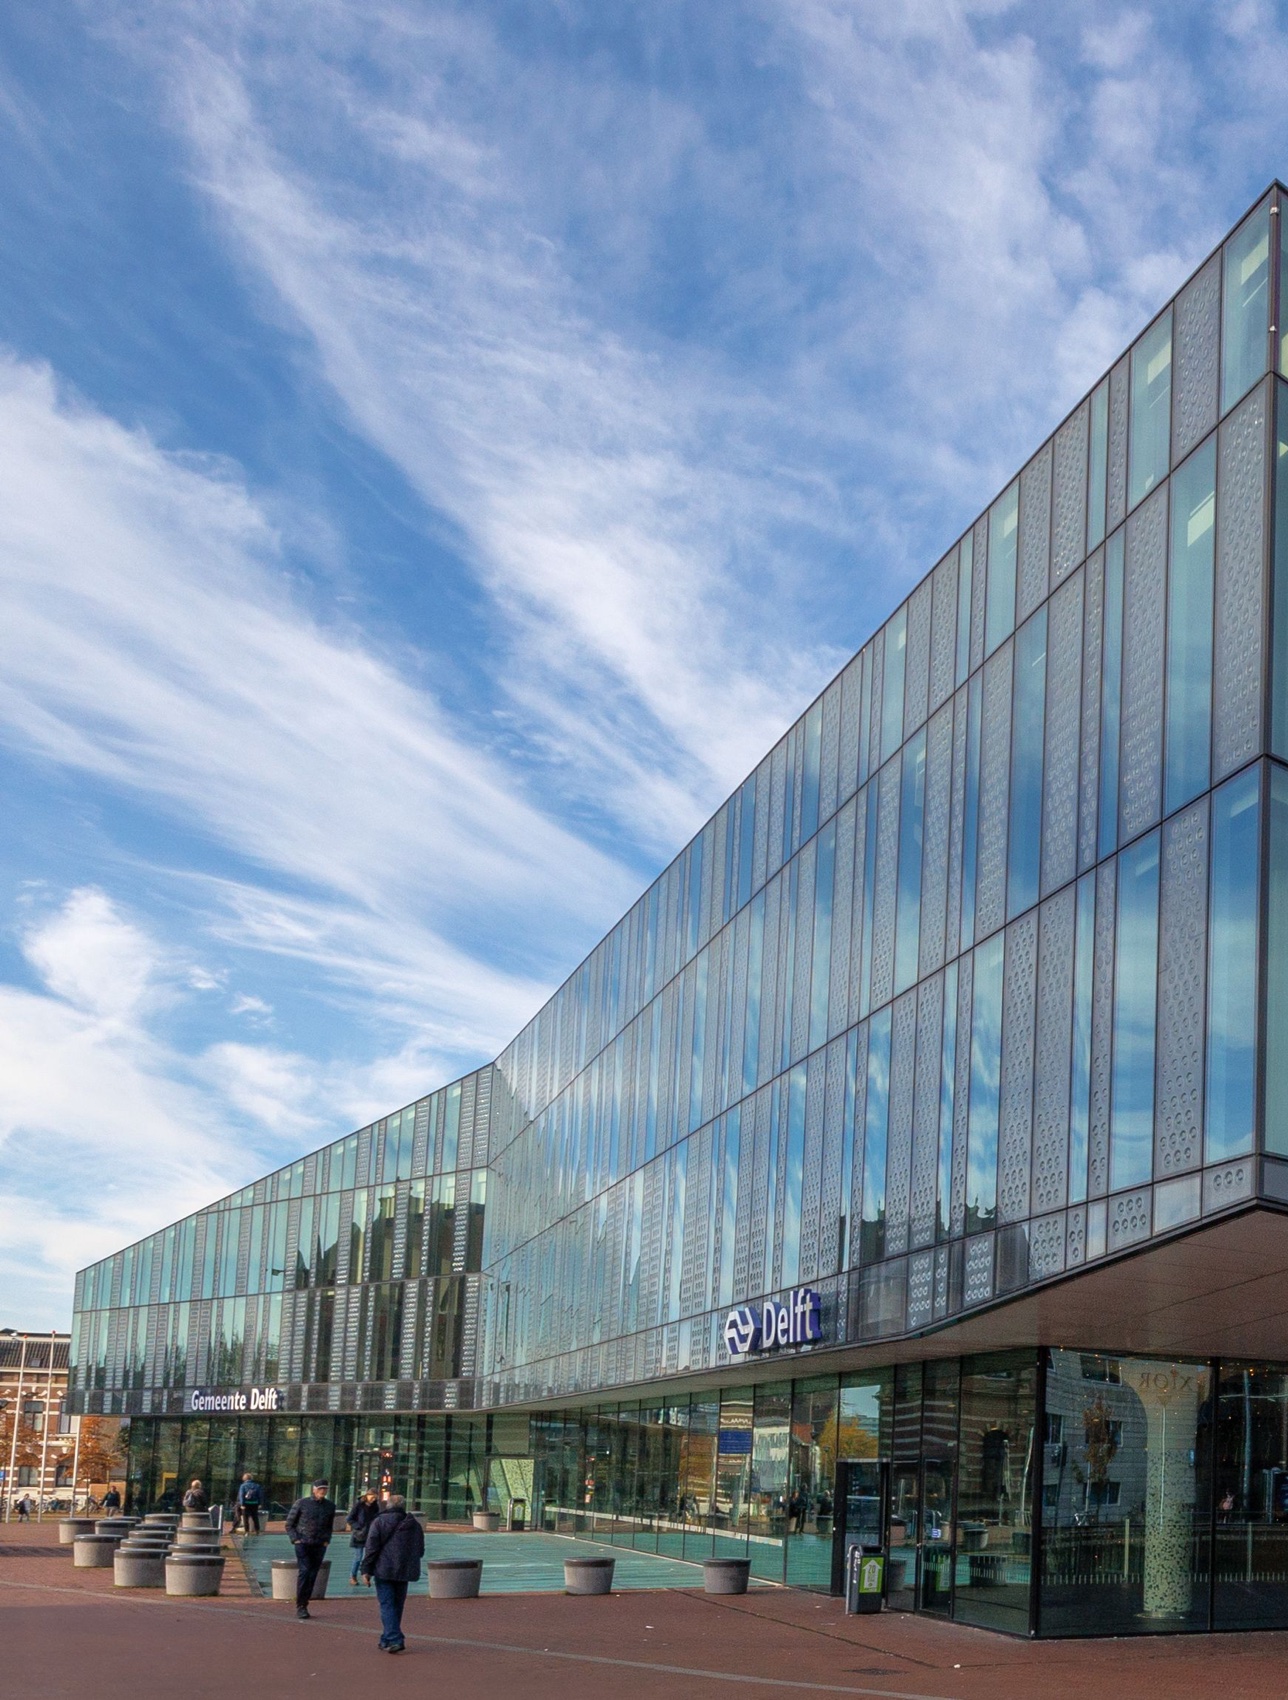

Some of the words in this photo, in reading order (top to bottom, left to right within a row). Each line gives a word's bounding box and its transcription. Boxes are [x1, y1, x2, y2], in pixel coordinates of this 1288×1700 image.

[762, 1288, 813, 1349] Delft
[191, 1390, 247, 1410] Gemeente
[250, 1387, 278, 1410] Delft
